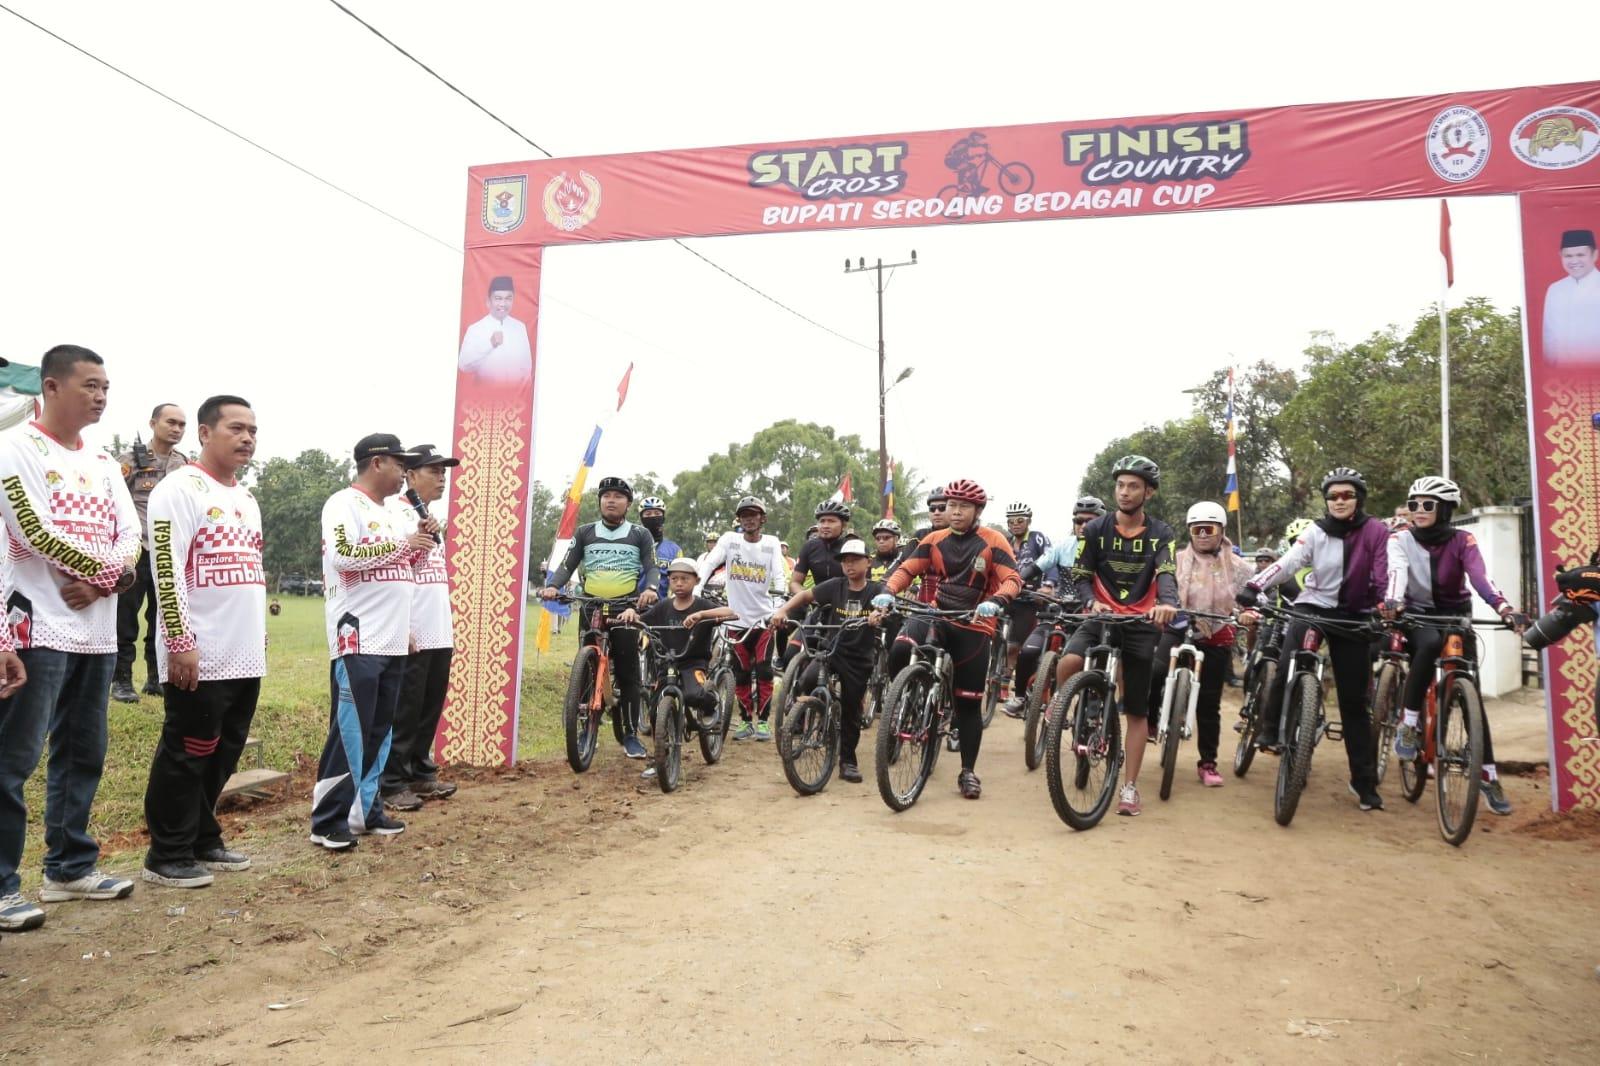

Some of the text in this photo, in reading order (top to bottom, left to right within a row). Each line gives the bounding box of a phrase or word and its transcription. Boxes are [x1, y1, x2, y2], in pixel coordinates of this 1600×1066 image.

[752, 123, 1241, 187] START FINISH
[807, 152, 1244, 196] CROSS COUNTRY
[762, 183, 1215, 225] BUPATI SERDANG BEDAGAI CUP
[2, 474, 104, 577] SERDANG BEDAGAI
[154, 520, 184, 638] ERDANG BEDAGAI
[198, 553, 233, 566] Explore
[730, 573, 767, 584] MEDAN
